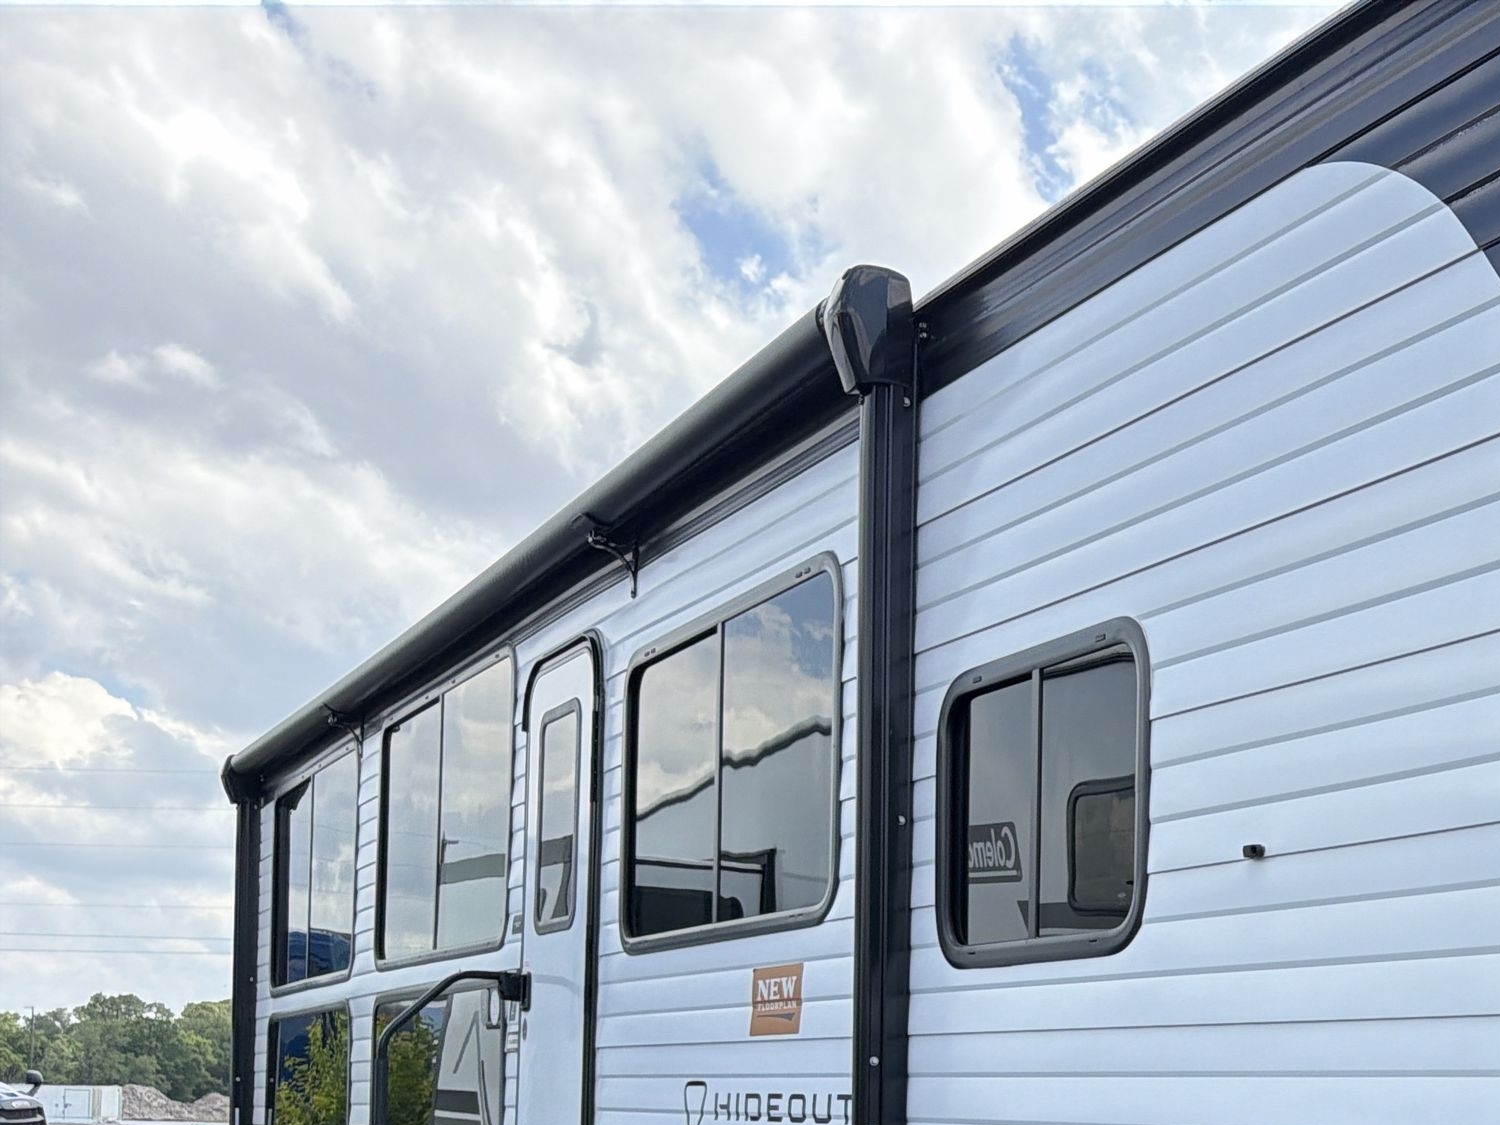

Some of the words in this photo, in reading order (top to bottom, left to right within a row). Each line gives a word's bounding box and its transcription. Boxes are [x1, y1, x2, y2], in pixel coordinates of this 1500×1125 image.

[756, 975, 798, 1001] NEW
[756, 1000, 798, 1012] FLOORPLAN
[713, 1092, 853, 1125] HIDEOUT
